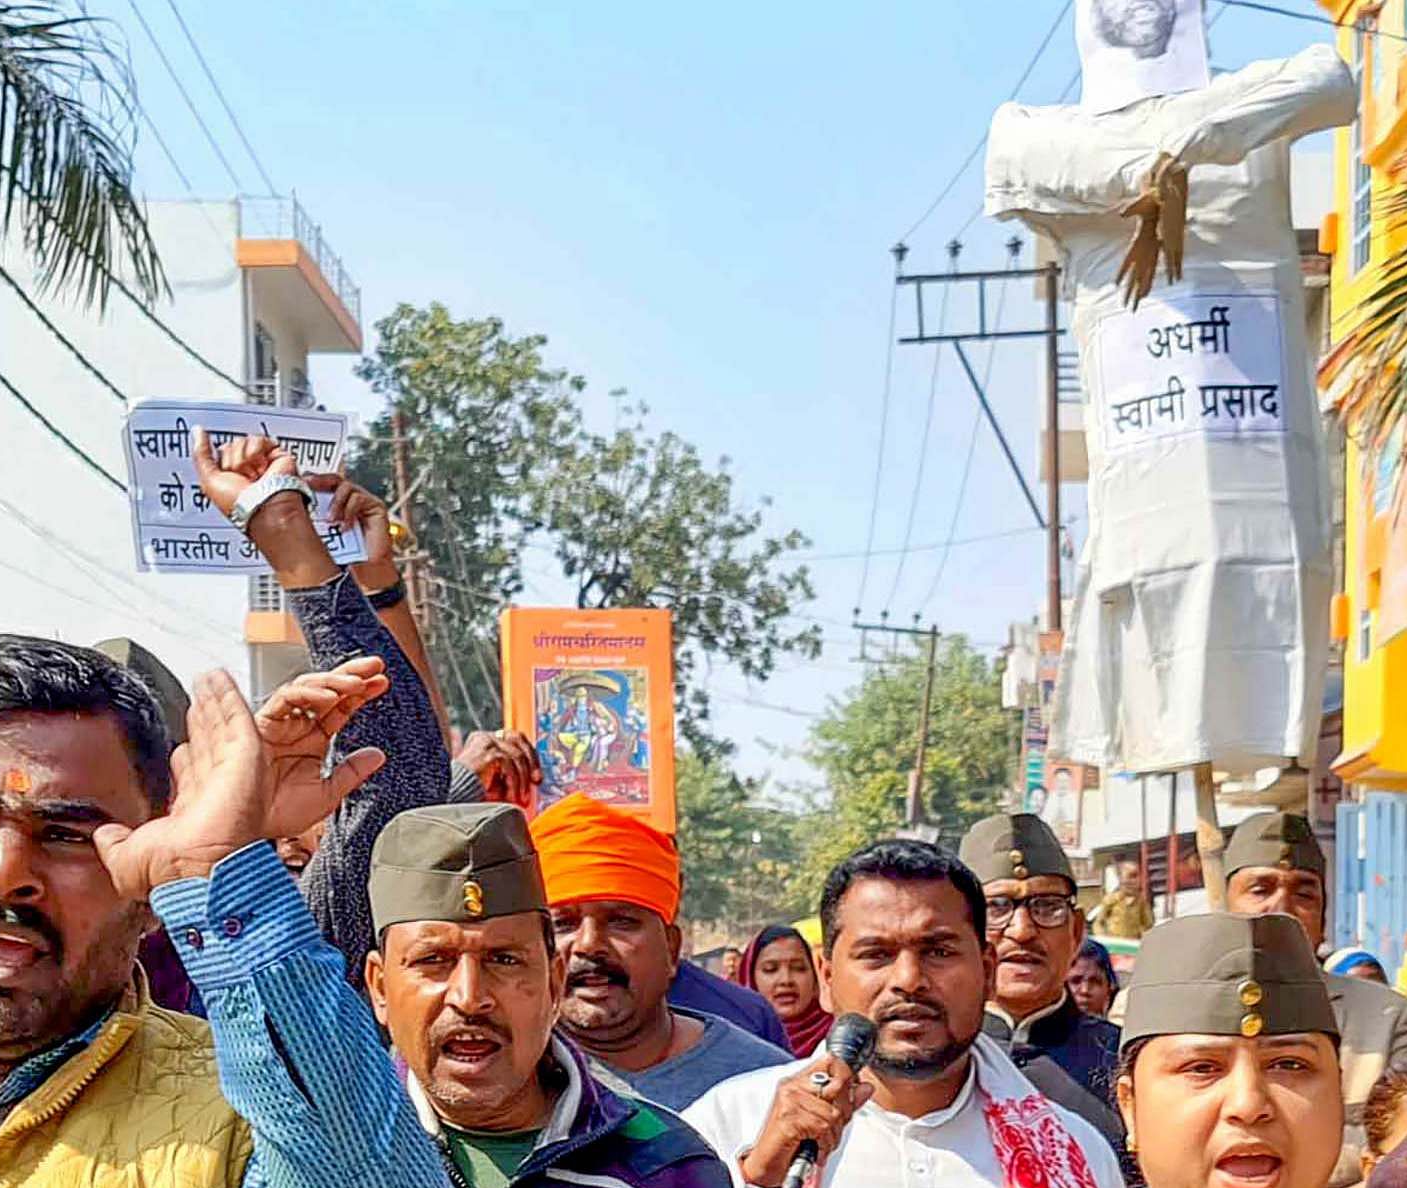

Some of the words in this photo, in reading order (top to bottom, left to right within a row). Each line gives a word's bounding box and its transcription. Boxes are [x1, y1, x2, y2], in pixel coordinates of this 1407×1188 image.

[1147, 306, 1230, 358] अधर्मी
[1111, 376, 1185, 433] स्वामी
[1199, 384, 1279, 419] प्रसाद
[133, 417, 190, 459] स्वामी
[159, 472, 184, 513] को
[151, 532, 230, 561] भारतीय
